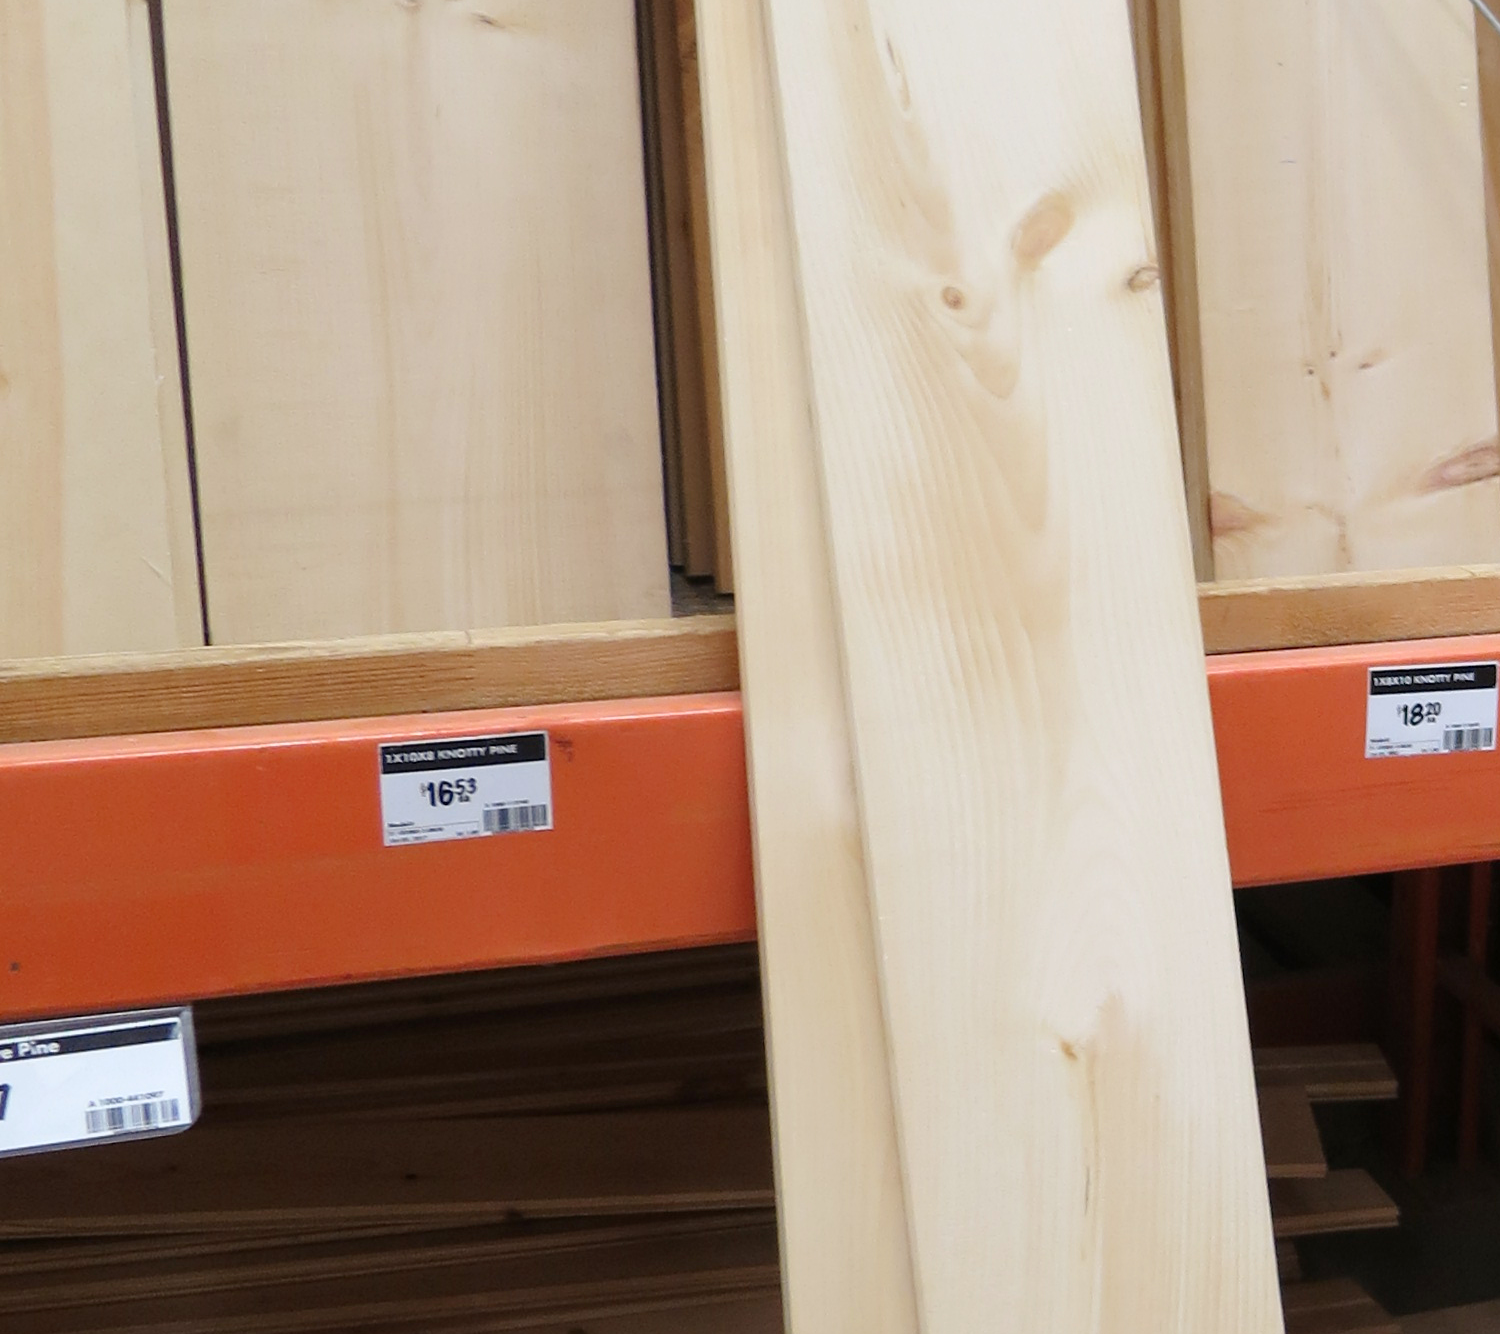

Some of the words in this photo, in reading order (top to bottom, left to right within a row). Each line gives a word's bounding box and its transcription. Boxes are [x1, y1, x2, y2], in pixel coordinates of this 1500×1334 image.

[1413, 673, 1452, 685] KNOTTY
[1452, 672, 1475, 682] PINE
[437, 746, 488, 760] KNOTTY
[489, 744, 518, 755] PINE
[18, 1041, 60, 1057] Pine
